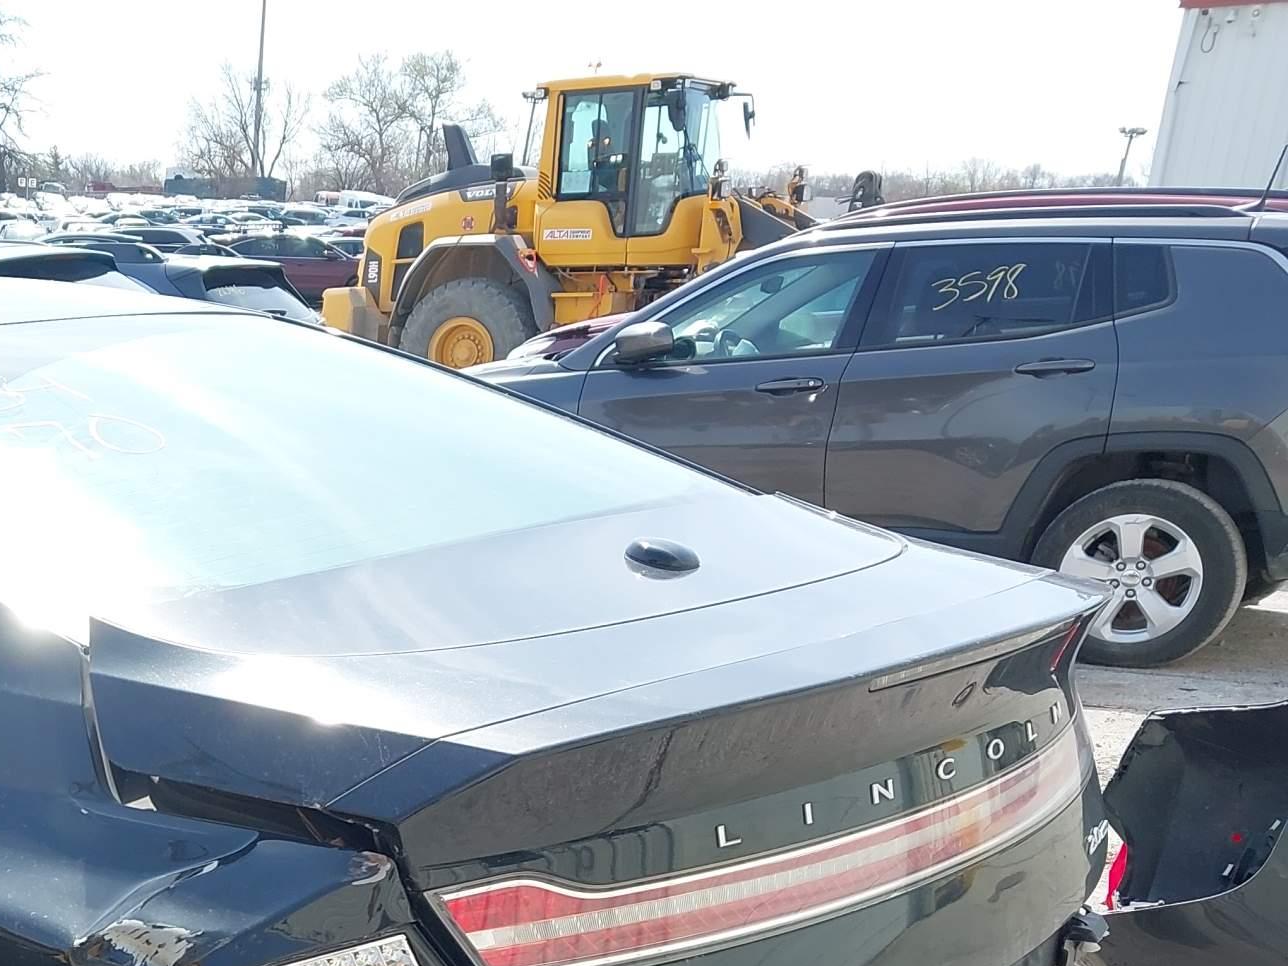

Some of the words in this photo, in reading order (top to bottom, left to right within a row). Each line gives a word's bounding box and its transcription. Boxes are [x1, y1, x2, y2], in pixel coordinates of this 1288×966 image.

[466, 187, 512, 199] VOL
[545, 230, 569, 239] ALTA
[367, 260, 379, 283] L90H
[930, 263, 1027, 311] 3598
[715, 700, 1063, 849] LINCOLN
